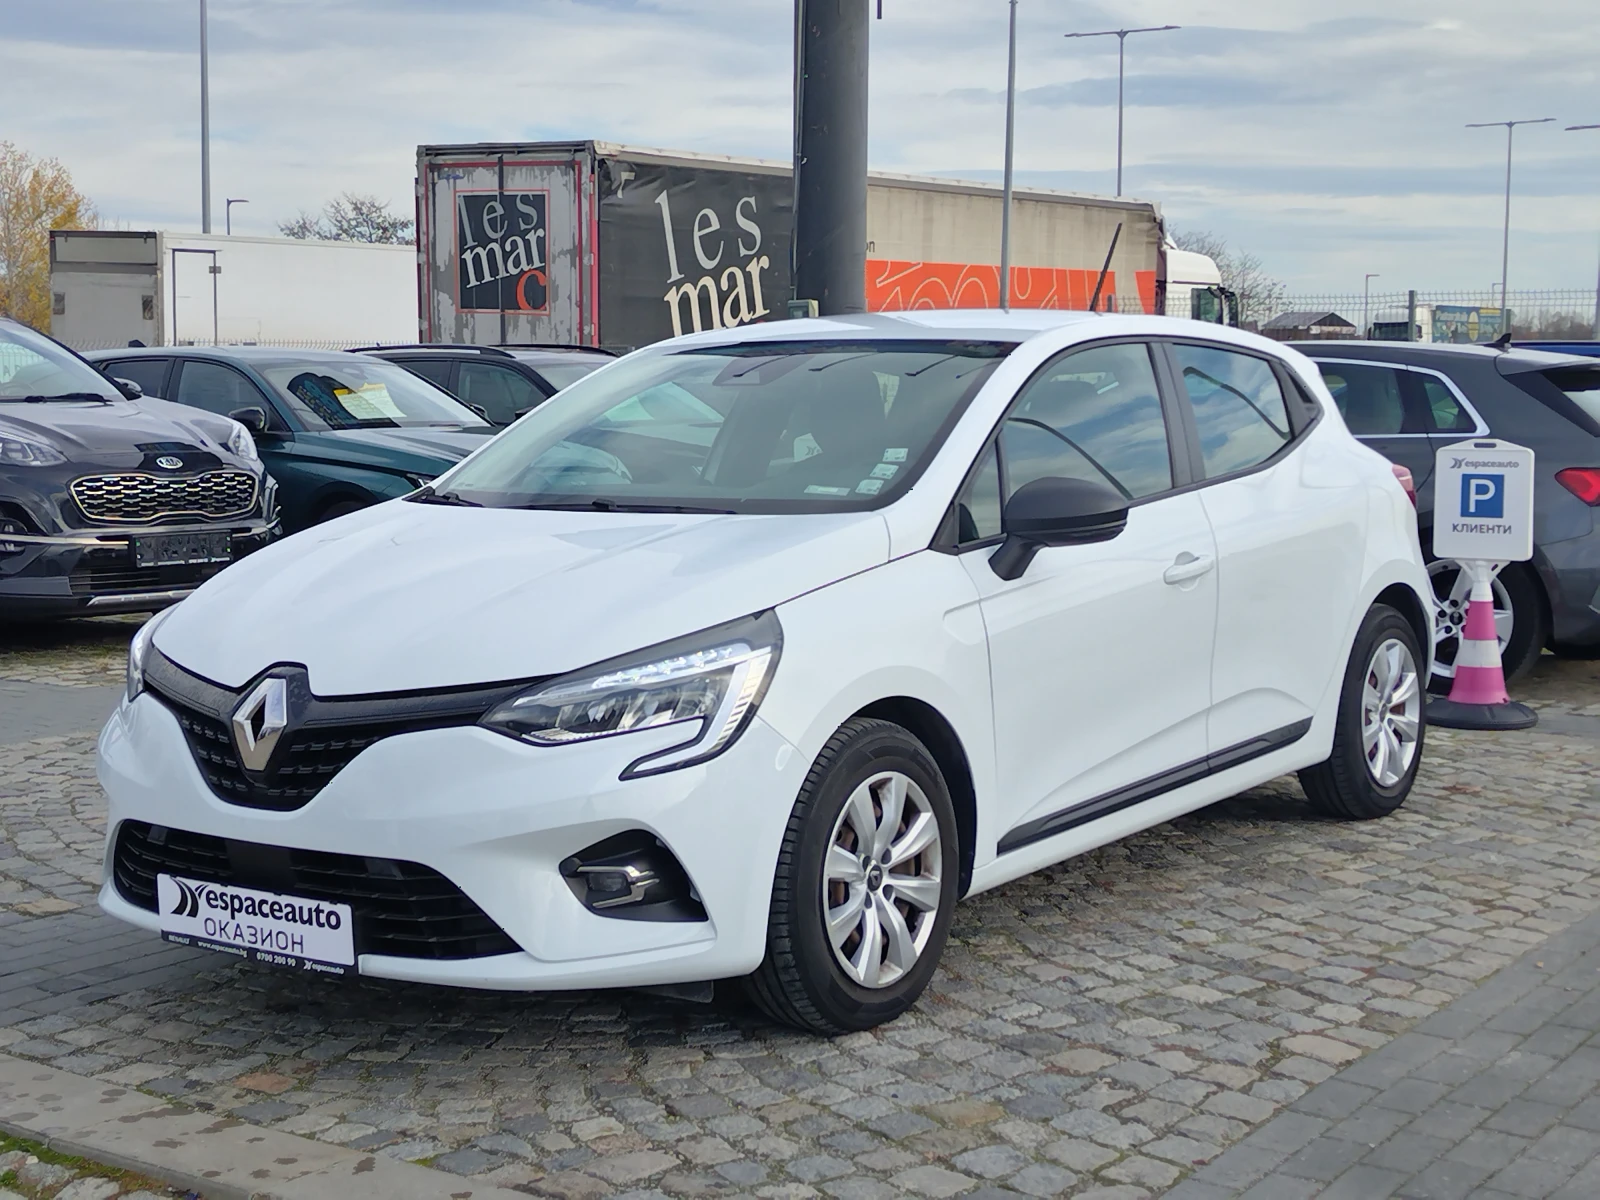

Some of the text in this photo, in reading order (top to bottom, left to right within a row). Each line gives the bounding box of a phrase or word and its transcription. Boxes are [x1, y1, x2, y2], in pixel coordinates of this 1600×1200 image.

[458, 194, 538, 249] les
[654, 189, 762, 283] les
[461, 227, 545, 288] mar
[663, 255, 771, 337] mar
[1465, 459, 1519, 469] espaceauto
[1469, 478, 1496, 513] P
[1452, 523, 1512, 534] КЛИЕНТИ
[206, 889, 341, 930] espaceauto
[204, 917, 304, 954] ОКАЗИОН
[256, 951, 273, 963] 0700
[274, 955, 286, 965] 200
